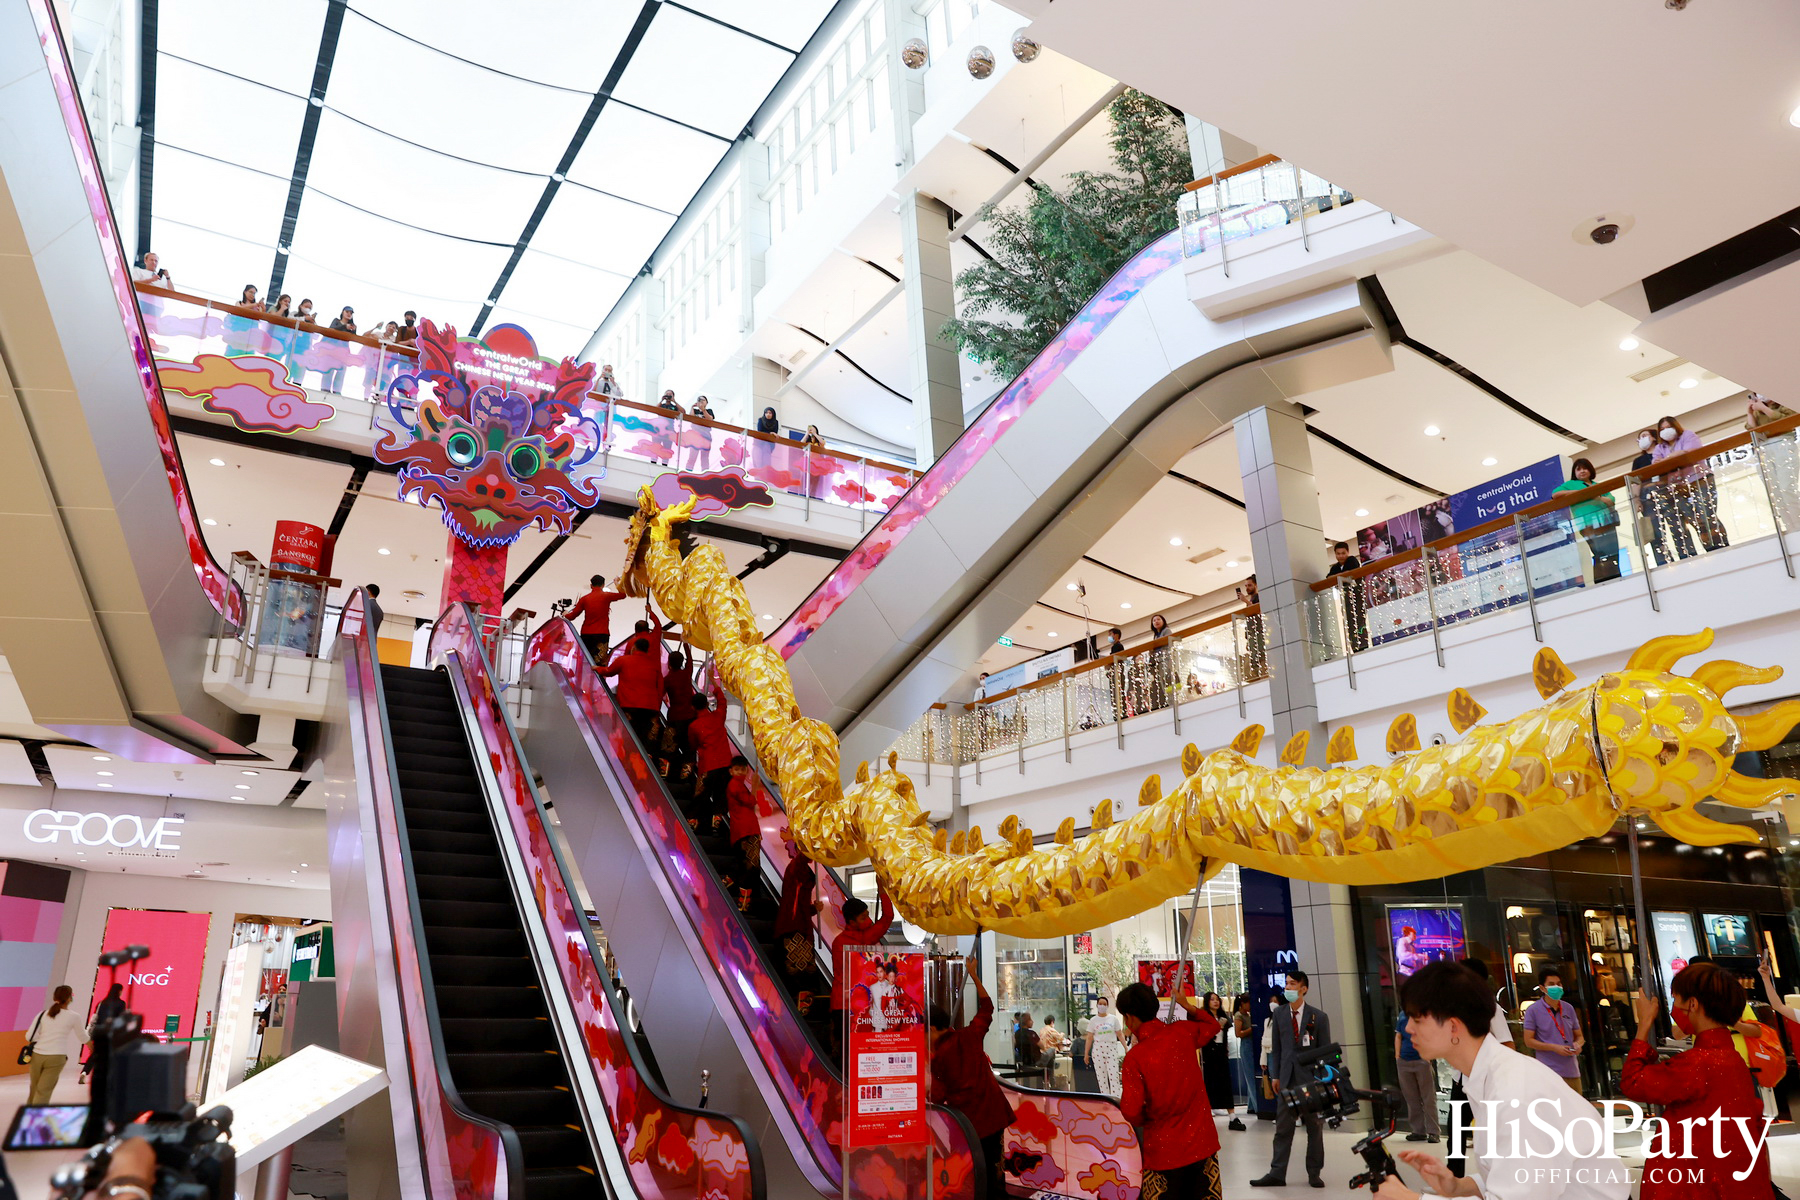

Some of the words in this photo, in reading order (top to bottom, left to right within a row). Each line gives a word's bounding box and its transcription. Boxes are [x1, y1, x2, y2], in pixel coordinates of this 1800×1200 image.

[484, 359, 501, 370] THE
[502, 363, 530, 377] GREAT
[453, 361, 492, 377] CHINESE
[492, 371, 514, 382] NEW
[514, 375, 536, 388] YEAR
[536, 381, 556, 393] 2024
[1476, 473, 1533, 501] centralwOrld
[1509, 486, 1539, 507] thai
[278, 533, 318, 549] CENTARA
[277, 548, 316, 562] BANGKOK
[23, 808, 185, 851] GROOVE
[128, 973, 169, 986] NGG
[884, 1009, 905, 1017] GREAT
[902, 1016, 918, 1024] YEAR
